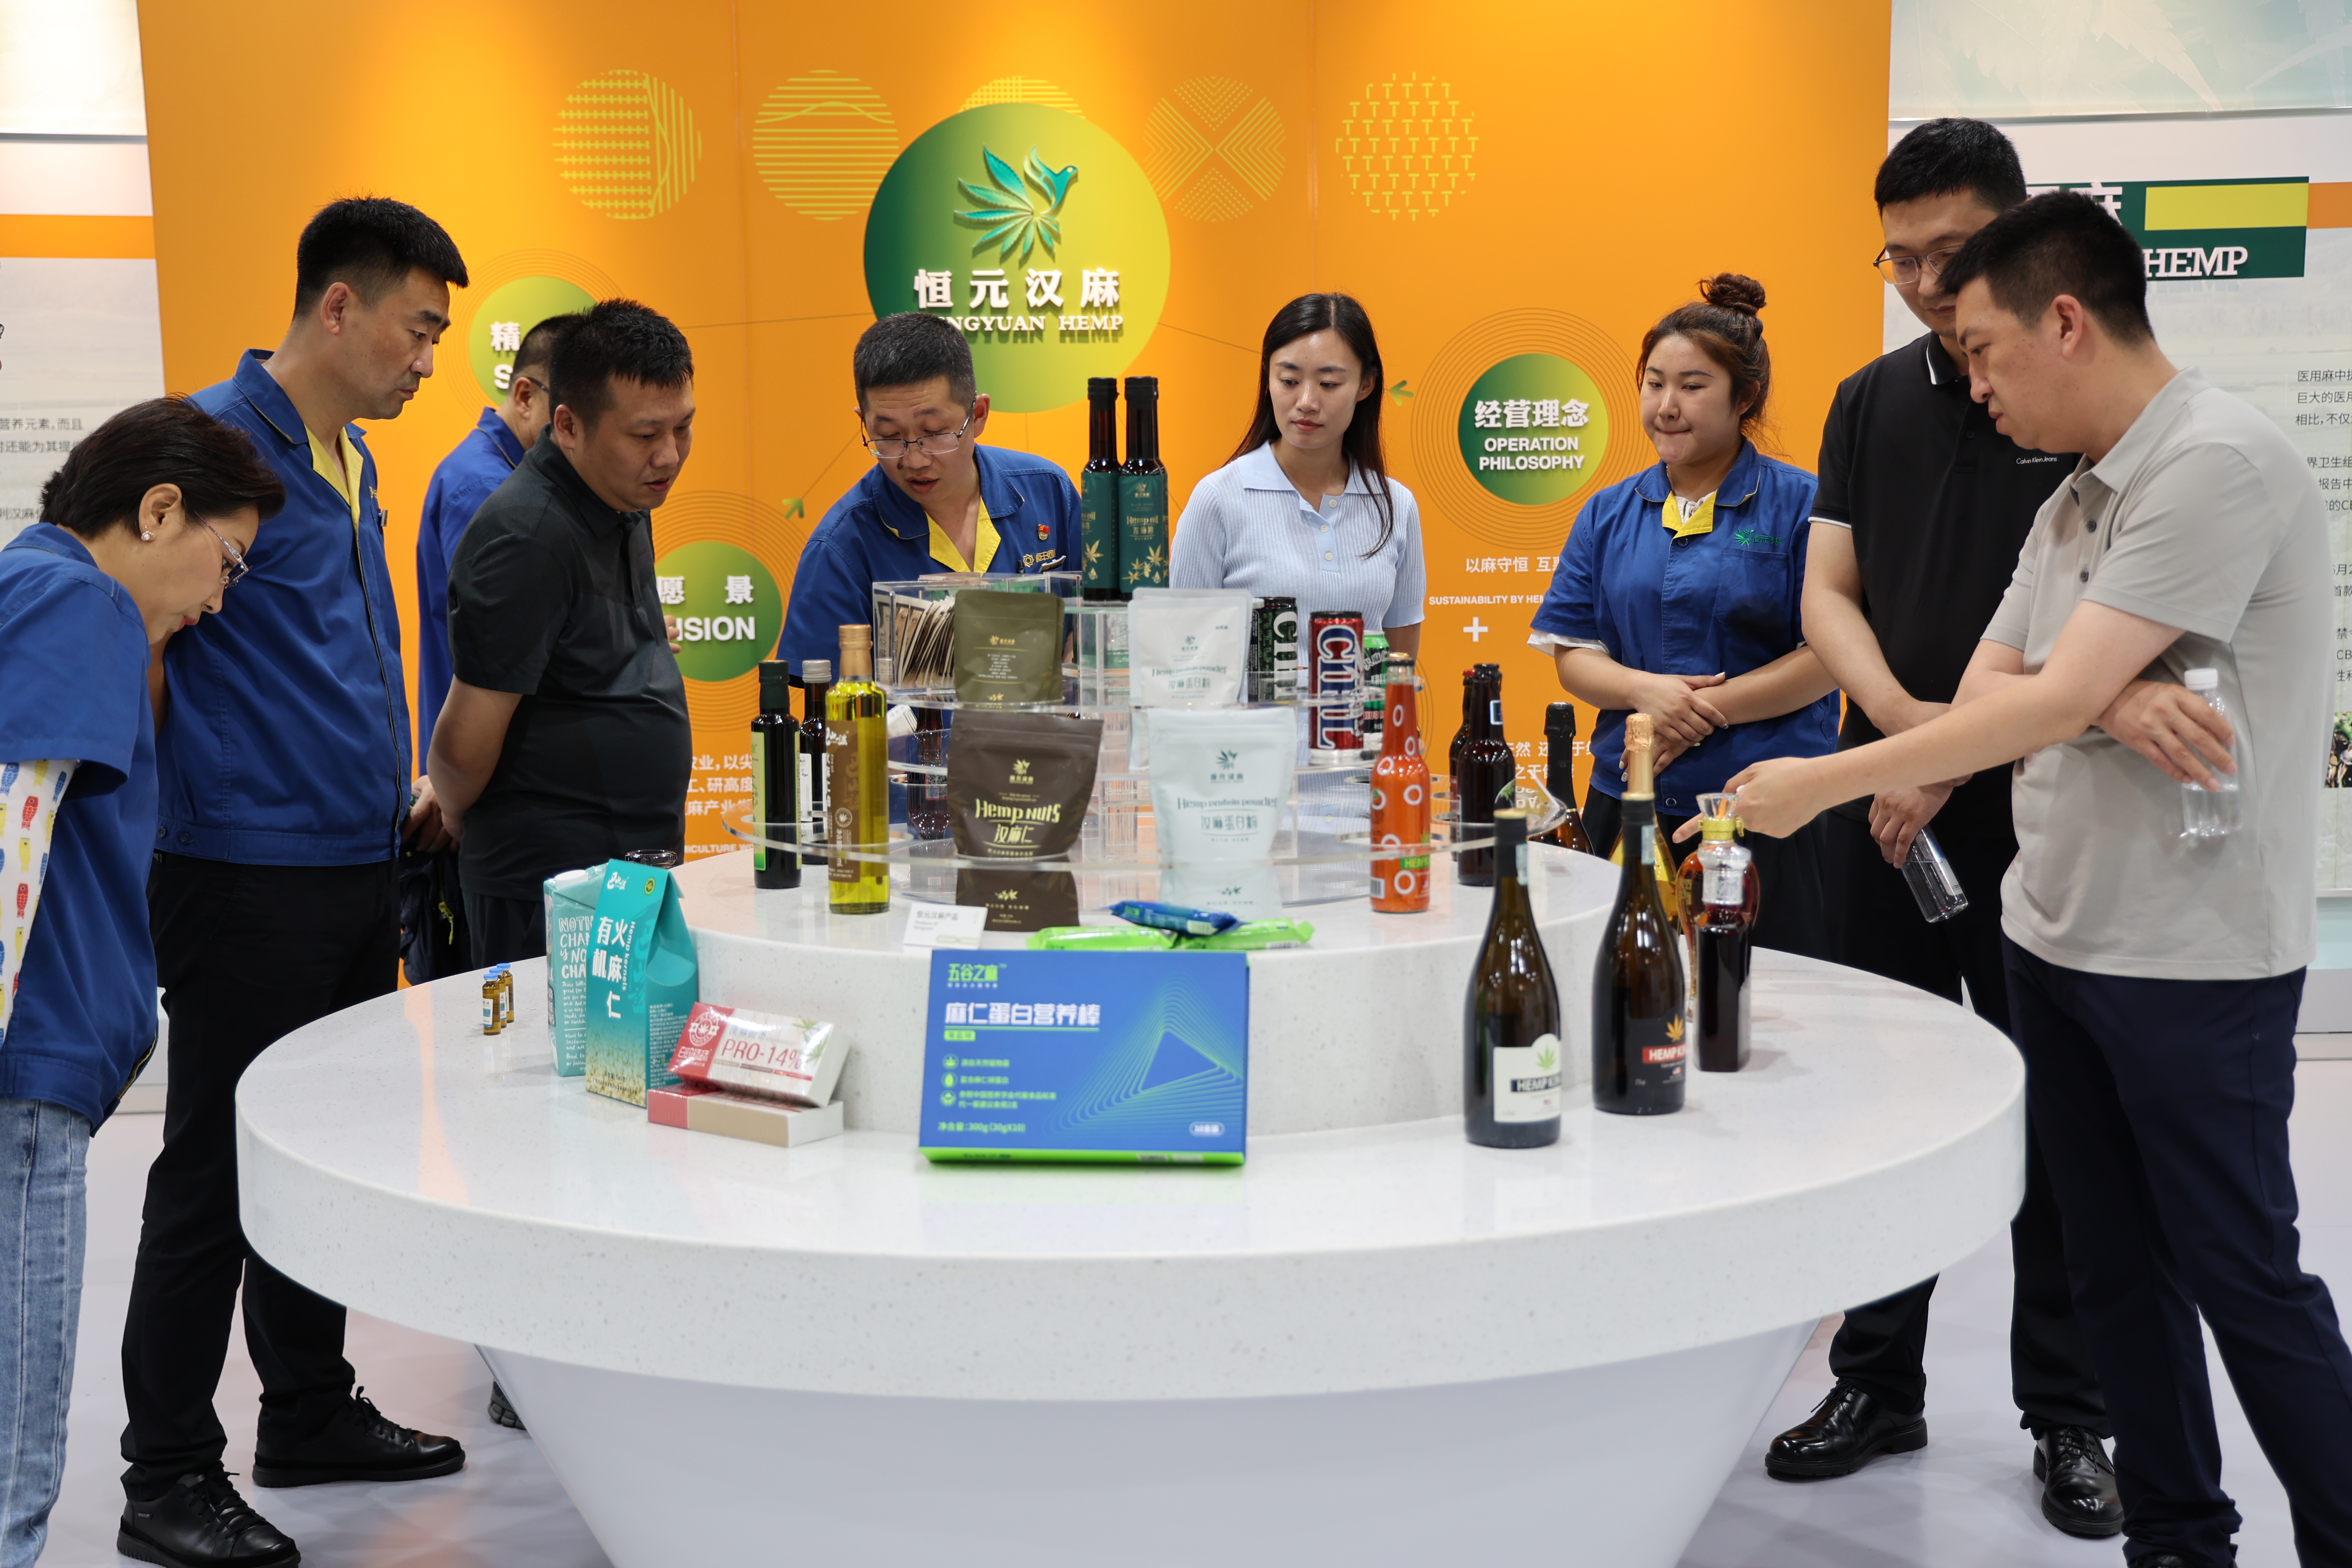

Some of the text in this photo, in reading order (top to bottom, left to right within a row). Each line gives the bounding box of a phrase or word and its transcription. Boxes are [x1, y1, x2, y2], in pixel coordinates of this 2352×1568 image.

[2145, 246, 2248, 278] HEMP
[913, 267, 1120, 309] 恒元汉麻
[945, 315, 1124, 331] NGYUAN HEMP
[1474, 399, 1589, 429] 经营理念
[0, 440, 77, 453] 还能为其提
[1484, 437, 1578, 452] OPERATION
[1479, 455, 1585, 470] PHILOSOPHY
[1465, 557, 1528, 573] 以麻守恒
[657, 574, 754, 605] 愿景
[1429, 595, 1507, 605] SUSTAINABILITY
[1510, 595, 1524, 604] BY
[669, 616, 756, 642] ISION
[975, 798, 1024, 825] Hemp
[1178, 797, 1207, 810] Hemp
[993, 823, 1035, 844] 汉麻仁
[592, 916, 613, 979] 有机
[622, 921, 636, 991] Hemp kernels
[606, 918, 628, 1019] 火麻仁
[948, 963, 998, 982] 五谷之麻
[945, 1002, 1101, 1026] 麻仁蛋白营养棒
[721, 1038, 803, 1069] PRO-14%
